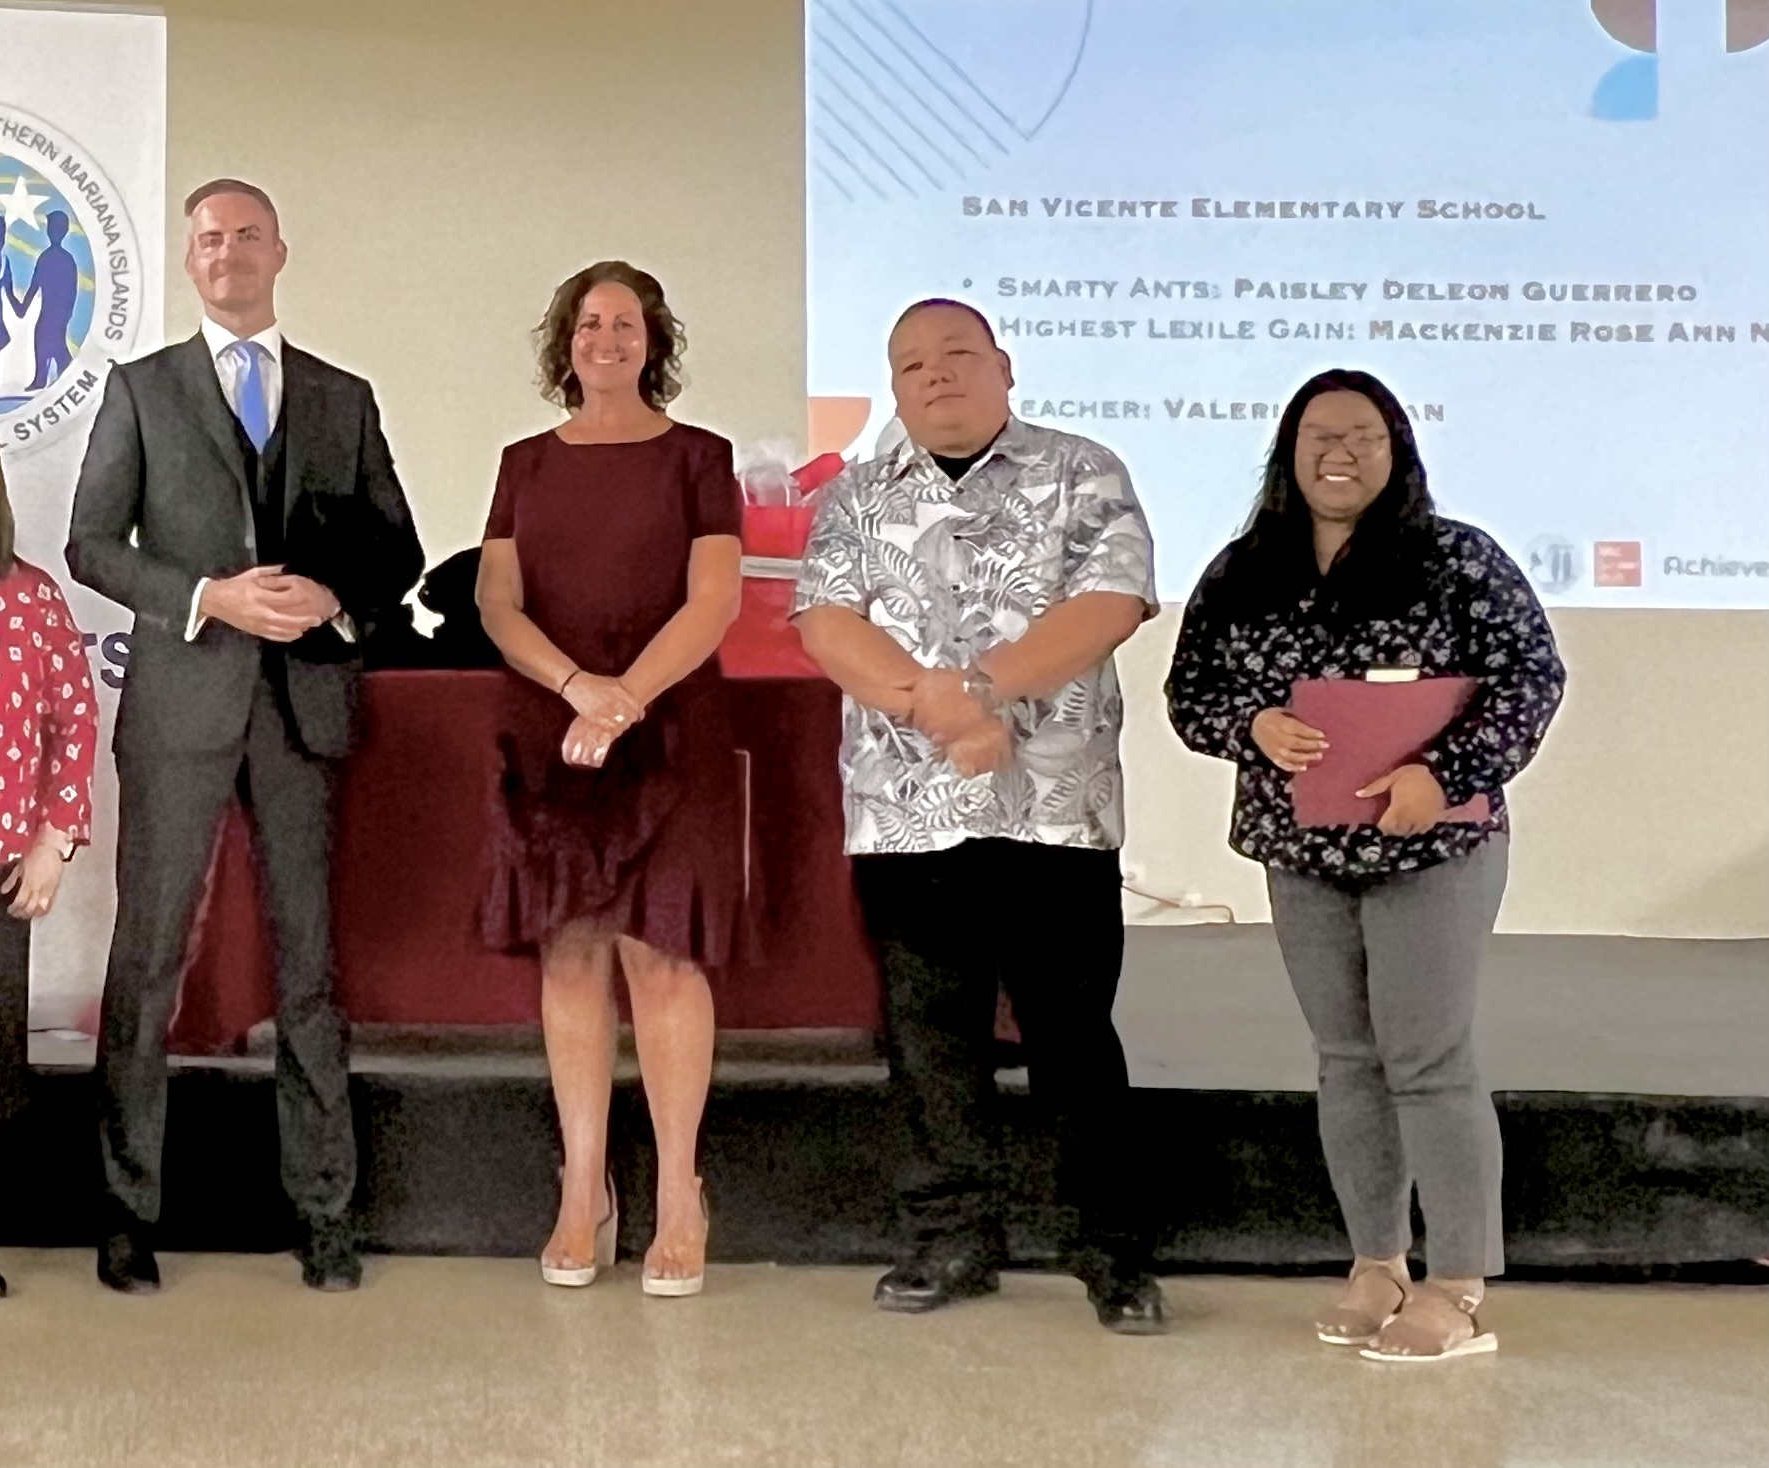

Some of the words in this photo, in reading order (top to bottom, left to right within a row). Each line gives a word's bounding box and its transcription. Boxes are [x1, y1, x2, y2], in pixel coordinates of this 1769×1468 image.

[1040, 197, 1179, 219] VICENTE
[1191, 198, 1405, 220] ELEMENTARY
[1417, 199, 1546, 221] SCHOOL
[60, 155, 121, 248] MARIANA
[105, 249, 130, 341] ISLANDS
[997, 277, 1119, 298] SMARTY
[1234, 278, 1368, 300] PAISLEY
[1522, 281, 1697, 302] GUERRERO
[998, 316, 1137, 338] HIGHEST
[1148, 318, 1256, 340] LEXILE
[1268, 319, 1356, 341] GAIN:
[1369, 320, 1557, 342] MACKENZIE
[1570, 321, 1655, 343] ROSE
[13, 369, 99, 441] SYSTEM
[1015, 398, 1151, 419] EACHER:
[1163, 398, 1280, 421] VALERI
